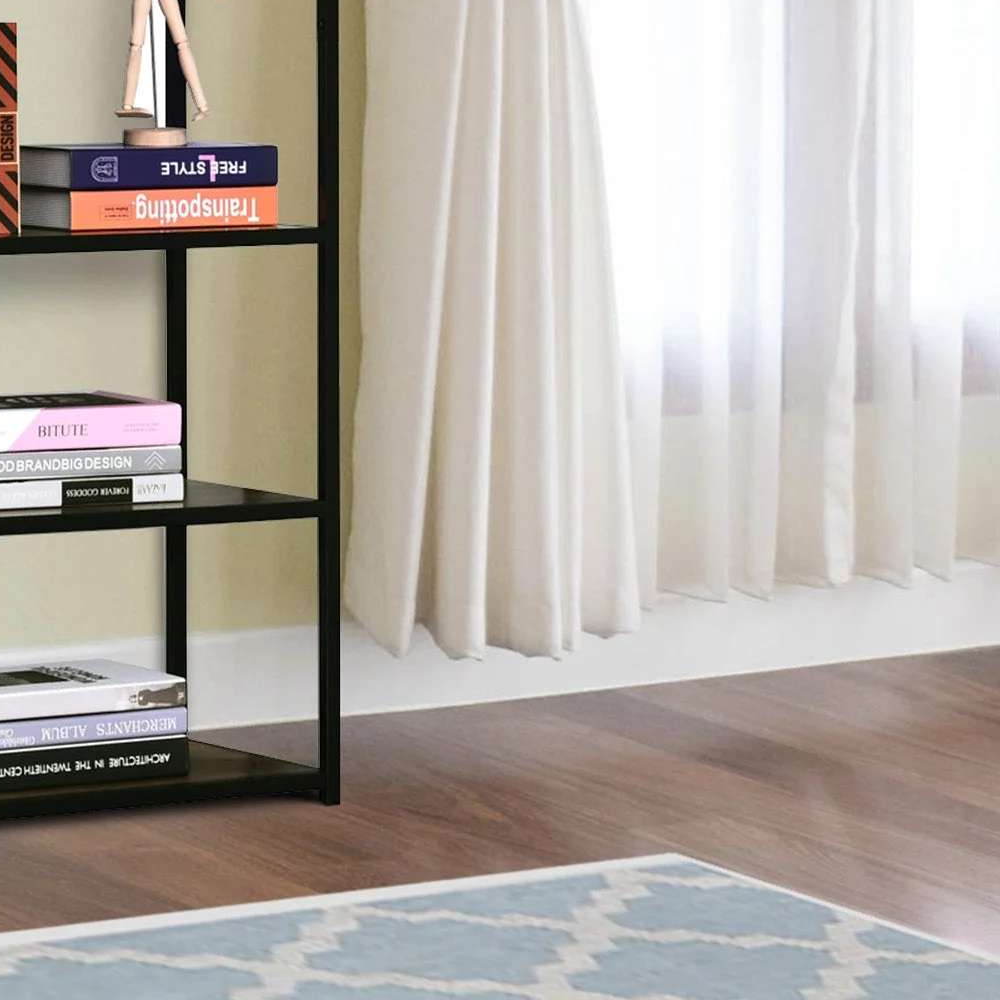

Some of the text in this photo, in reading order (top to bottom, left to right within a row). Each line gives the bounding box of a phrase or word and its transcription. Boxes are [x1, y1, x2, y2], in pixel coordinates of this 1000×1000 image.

[0, 115, 14, 161] DESIGN
[161, 161, 206, 176] STYLE
[37, 423, 89, 438] BITUTE
[66, 487, 130, 498] FOREVER GODDESS
[41, 716, 177, 741] MERCHANTS ALBUM
[75, 760, 92, 771] THE
[94, 759, 105, 768] IN
[108, 753, 171, 768] ARCHITECTURE
[24, 762, 72, 775] TWENTIETH
